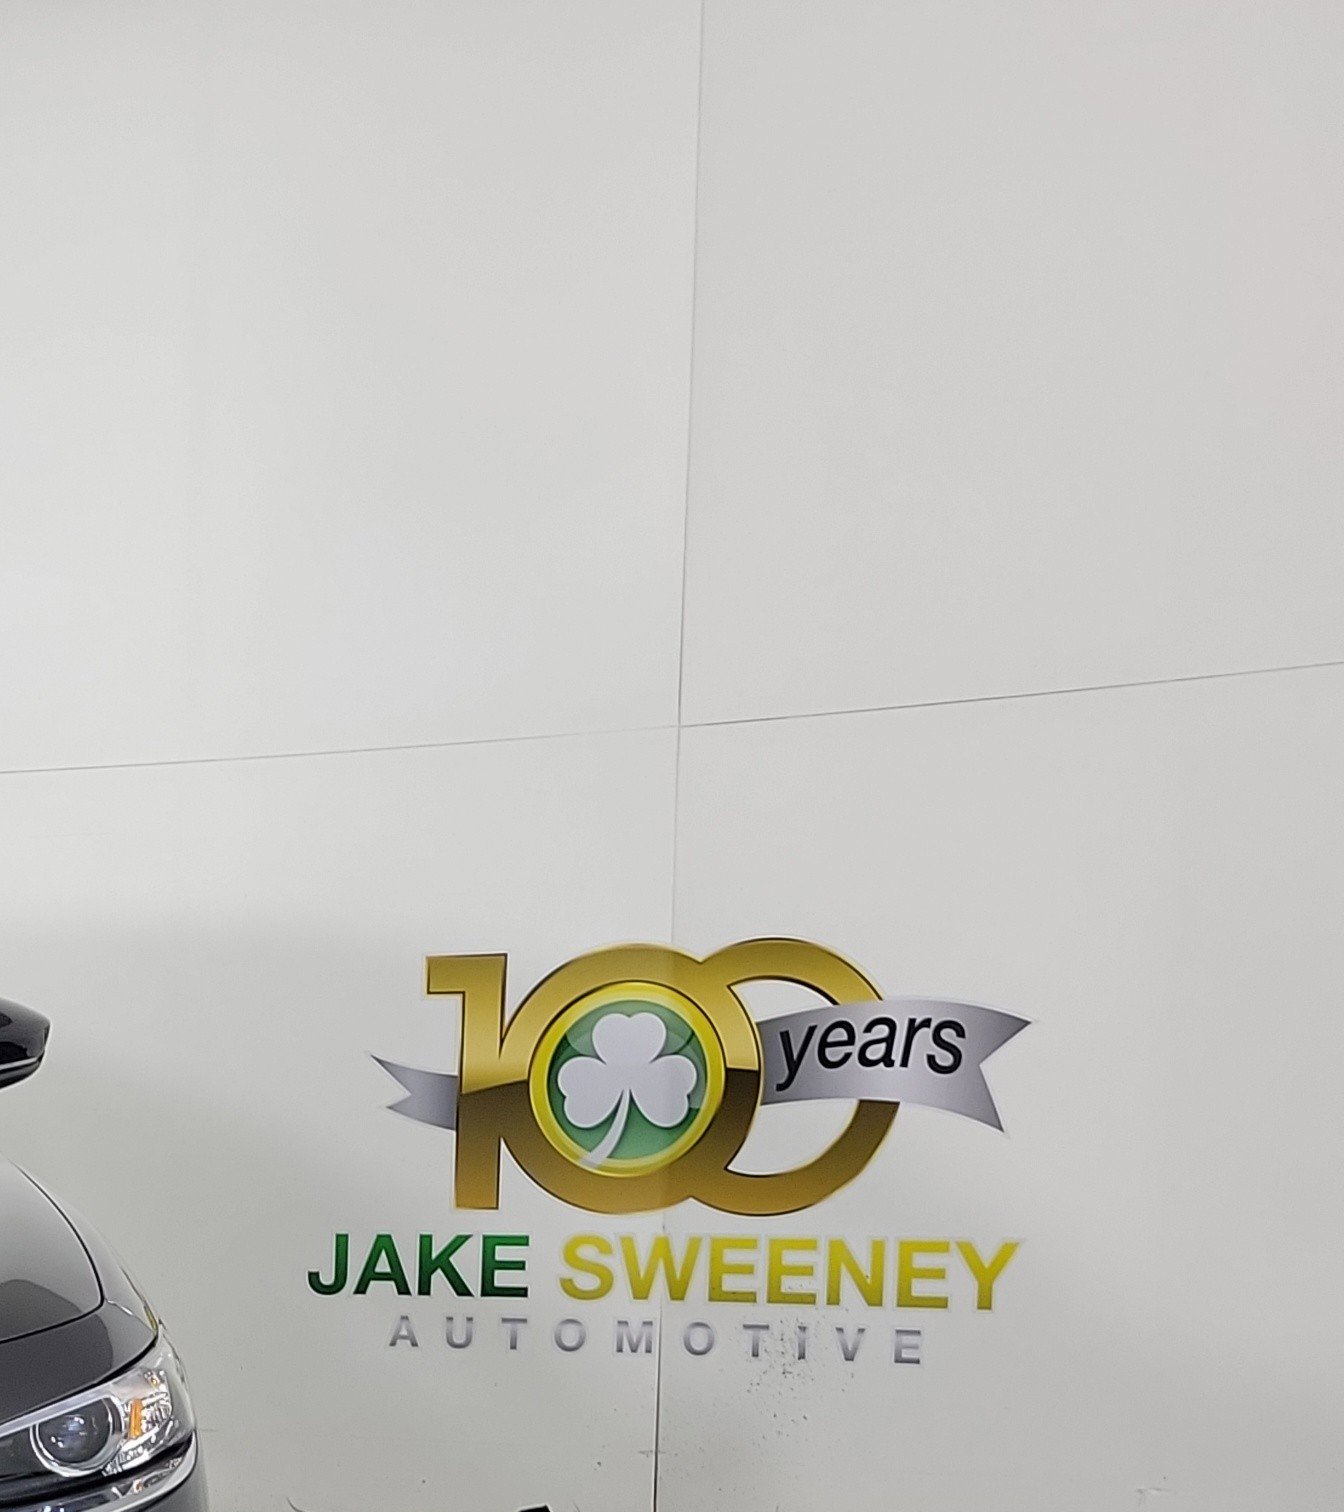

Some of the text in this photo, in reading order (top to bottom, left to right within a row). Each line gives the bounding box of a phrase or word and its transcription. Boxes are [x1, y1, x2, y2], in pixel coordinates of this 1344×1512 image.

[425, 937, 967, 1216] 100 years
[307, 1233, 1020, 1312] JAKE SWEENEY
[389, 1314, 922, 1365] AUTOMOTIVE
